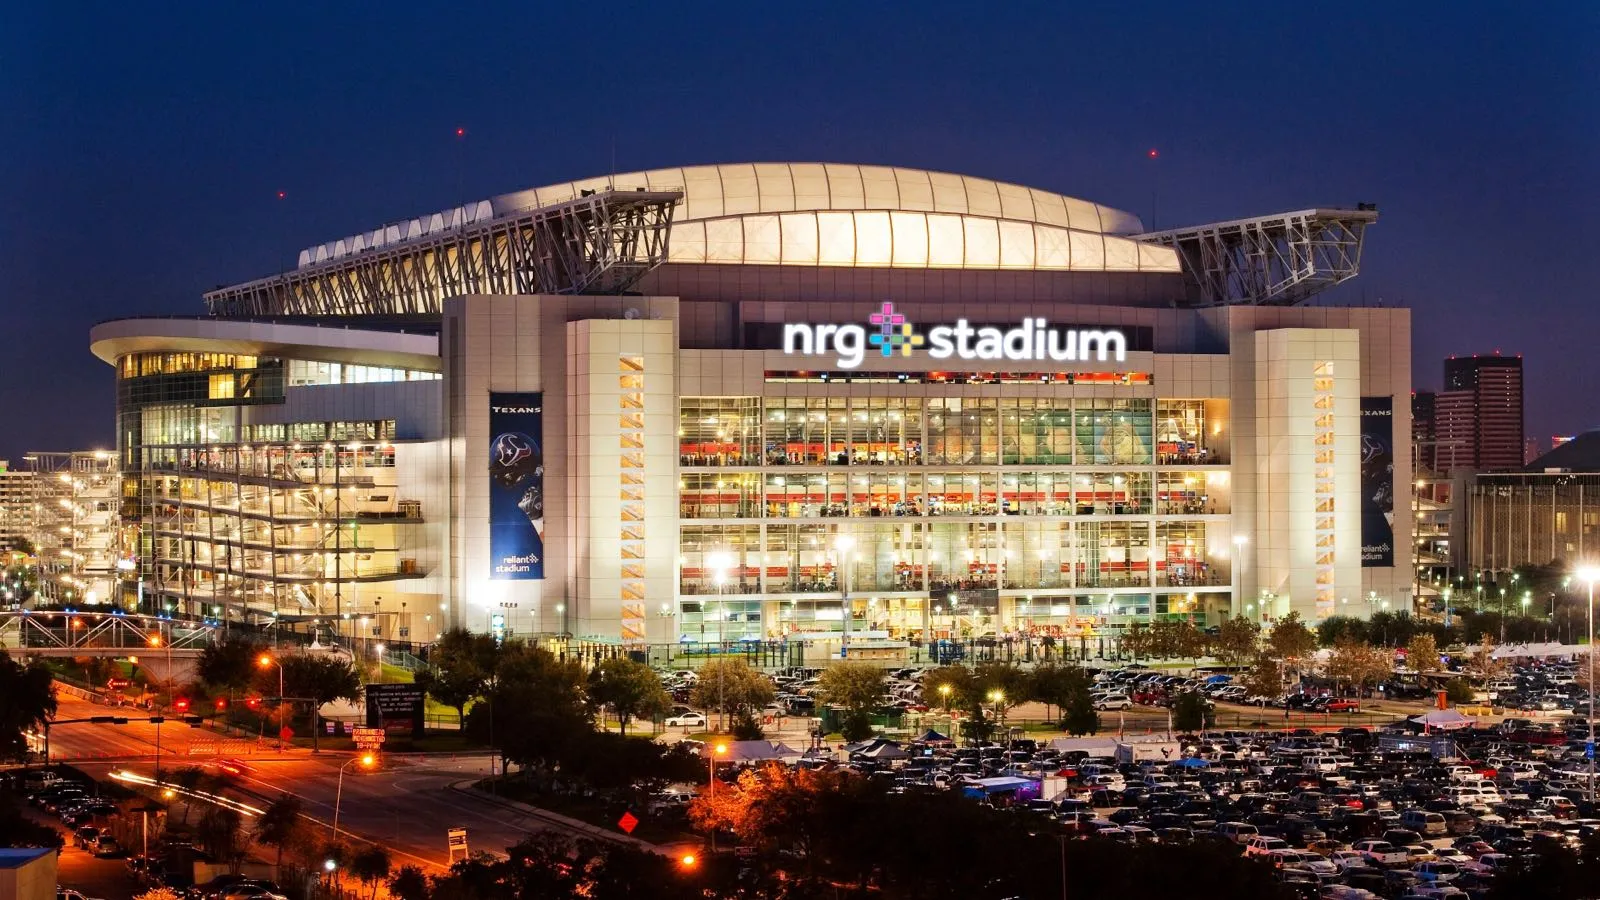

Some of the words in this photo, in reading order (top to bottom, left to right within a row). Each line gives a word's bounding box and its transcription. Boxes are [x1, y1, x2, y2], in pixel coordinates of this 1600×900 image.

[783, 322, 866, 368] nrg
[928, 318, 1127, 361] stadium
[503, 555, 530, 563] reliant
[496, 564, 530, 573] stadium
